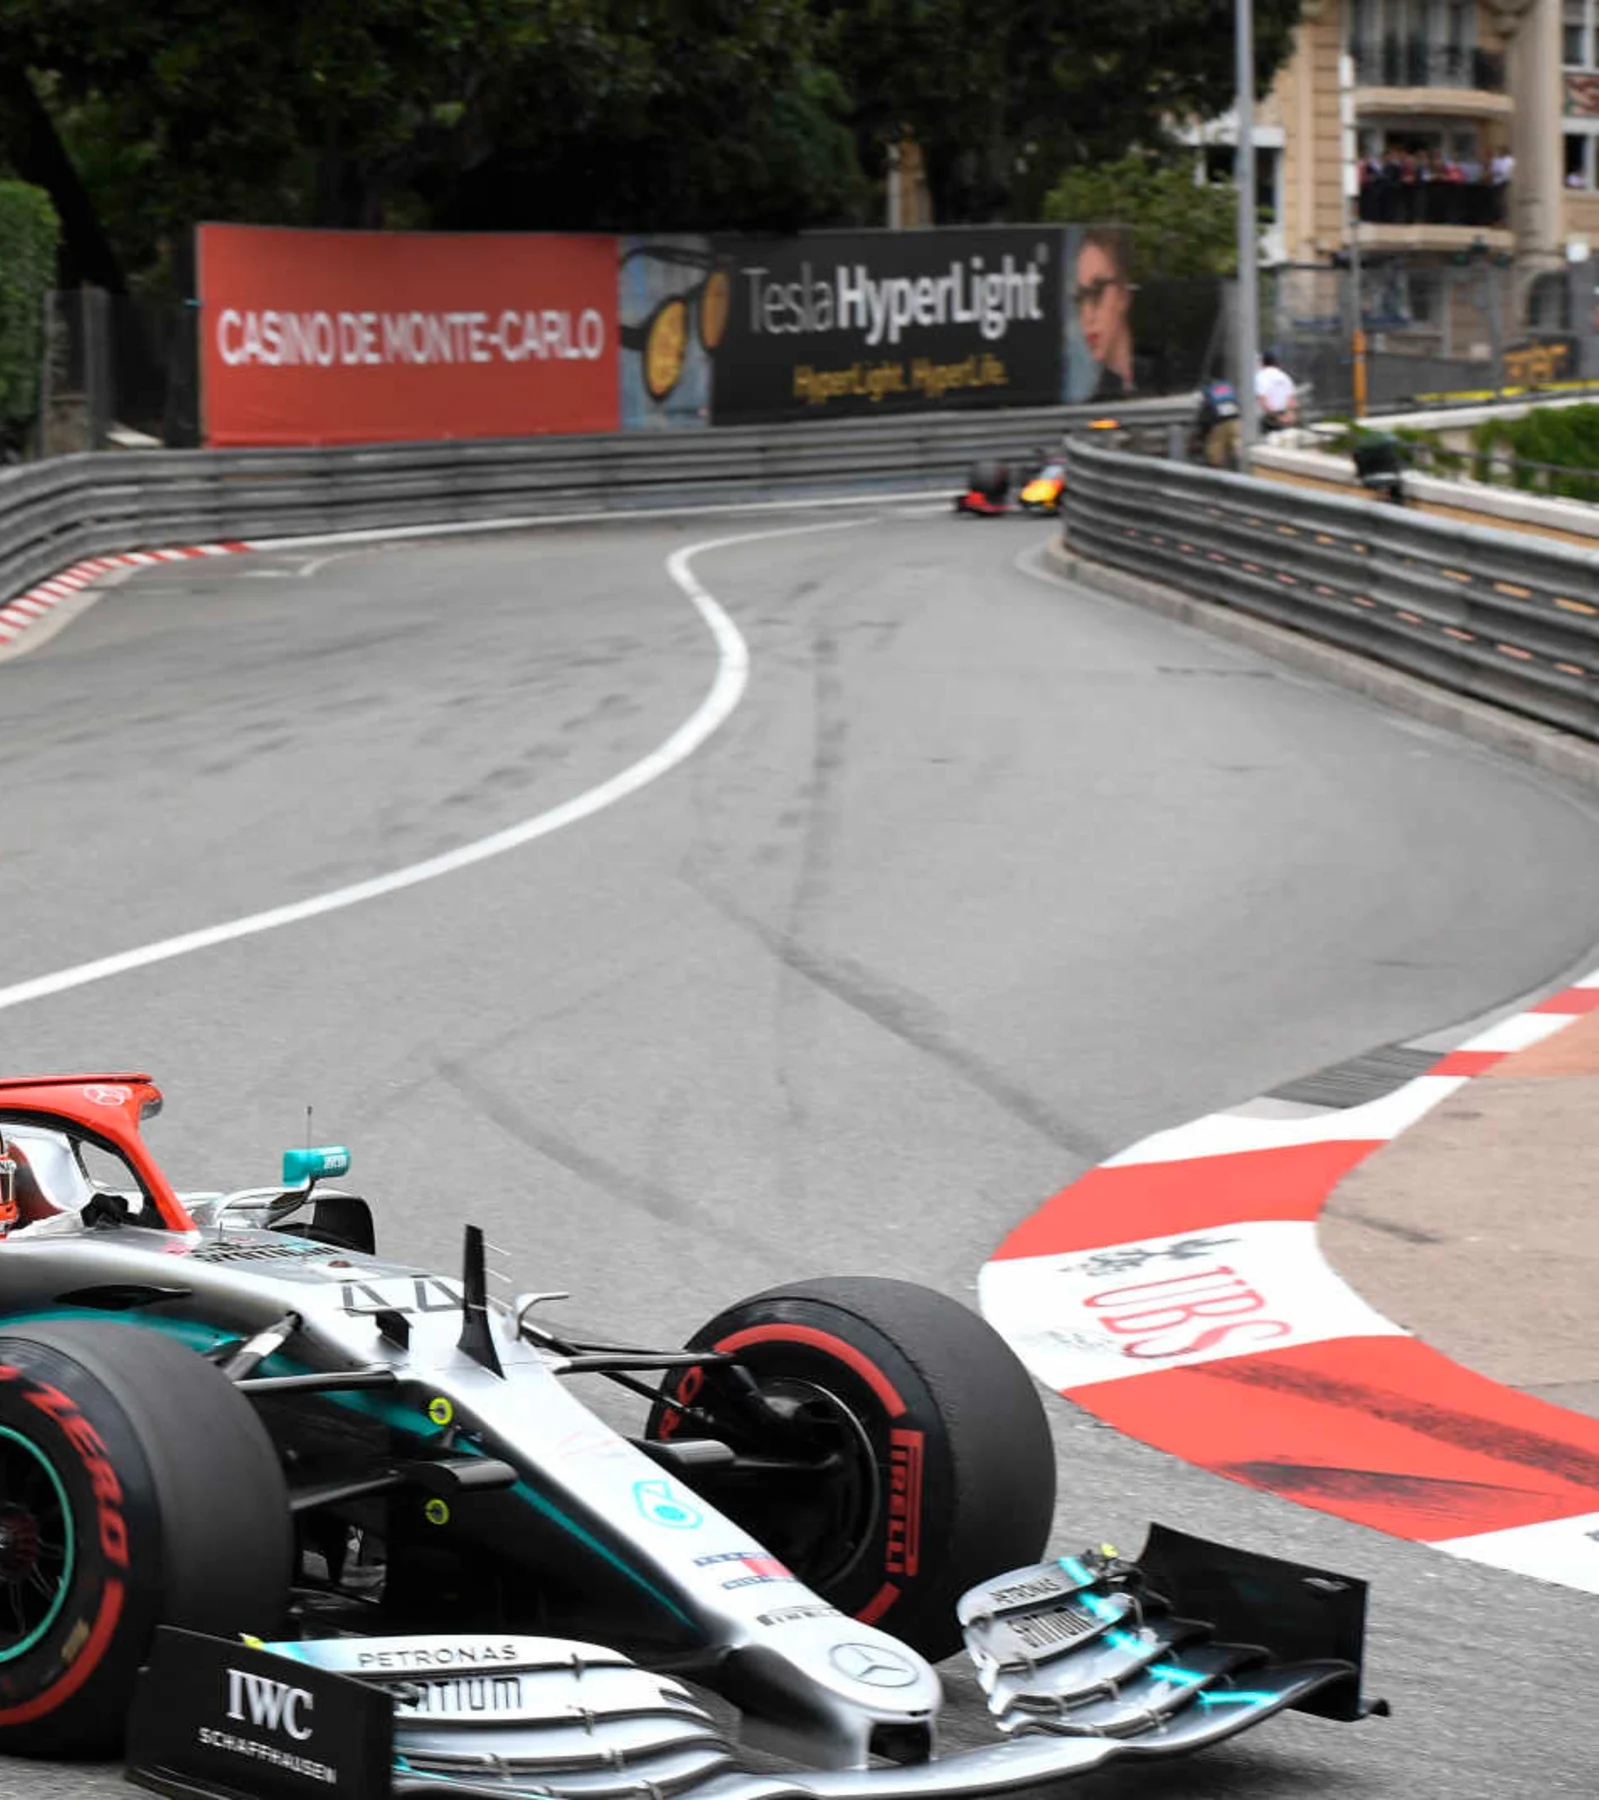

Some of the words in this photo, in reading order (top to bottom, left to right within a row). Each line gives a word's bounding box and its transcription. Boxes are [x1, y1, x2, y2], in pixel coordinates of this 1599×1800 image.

[217, 308, 334, 367] CASINO
[337, 311, 381, 364] DE
[383, 307, 605, 364] MONTE-CARLO
[1083, 1265, 1293, 1359] UBS
[357, 1645, 517, 1668] PETRONAS
[226, 1667, 314, 1741] IWC
[198, 1726, 338, 1785] SCHAFFHAUSEN
